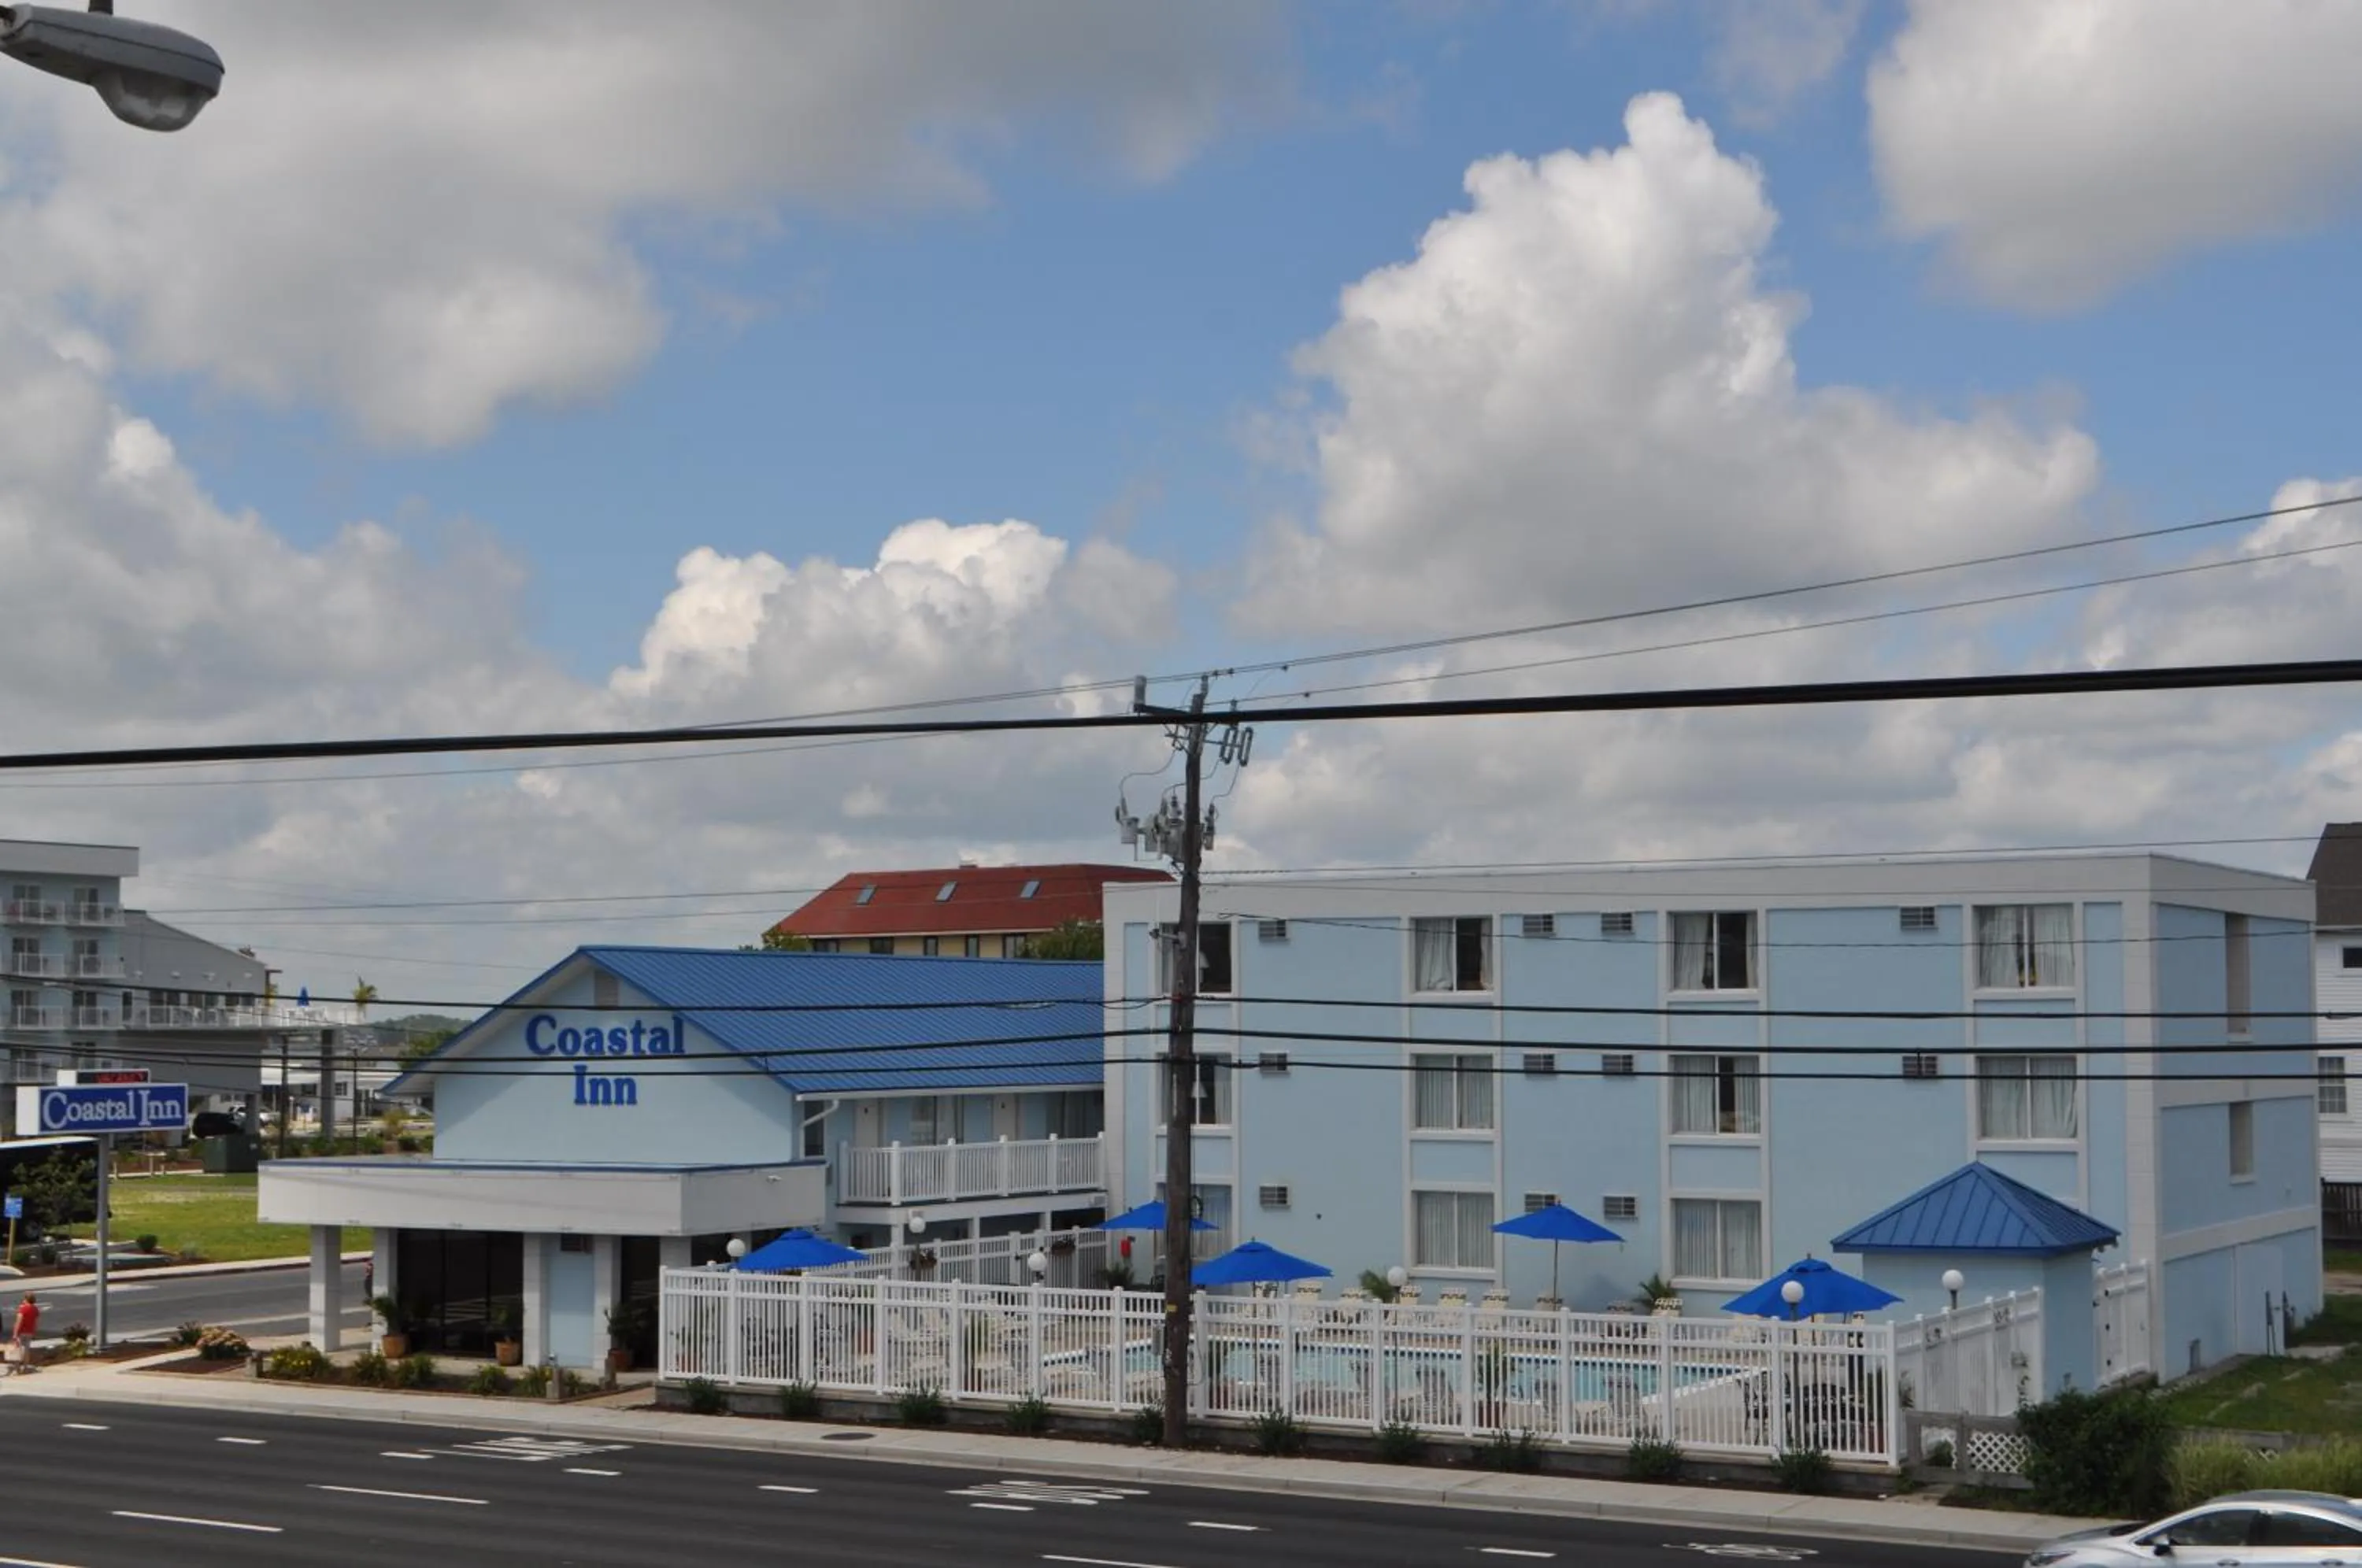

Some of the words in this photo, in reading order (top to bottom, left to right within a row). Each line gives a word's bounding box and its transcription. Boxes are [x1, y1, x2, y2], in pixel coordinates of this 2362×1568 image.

[525, 1014, 685, 1056] Coastal
[573, 1064, 638, 1106] Inn
[43, 1090, 136, 1130] Coastal
[138, 1089, 182, 1126] Inn
